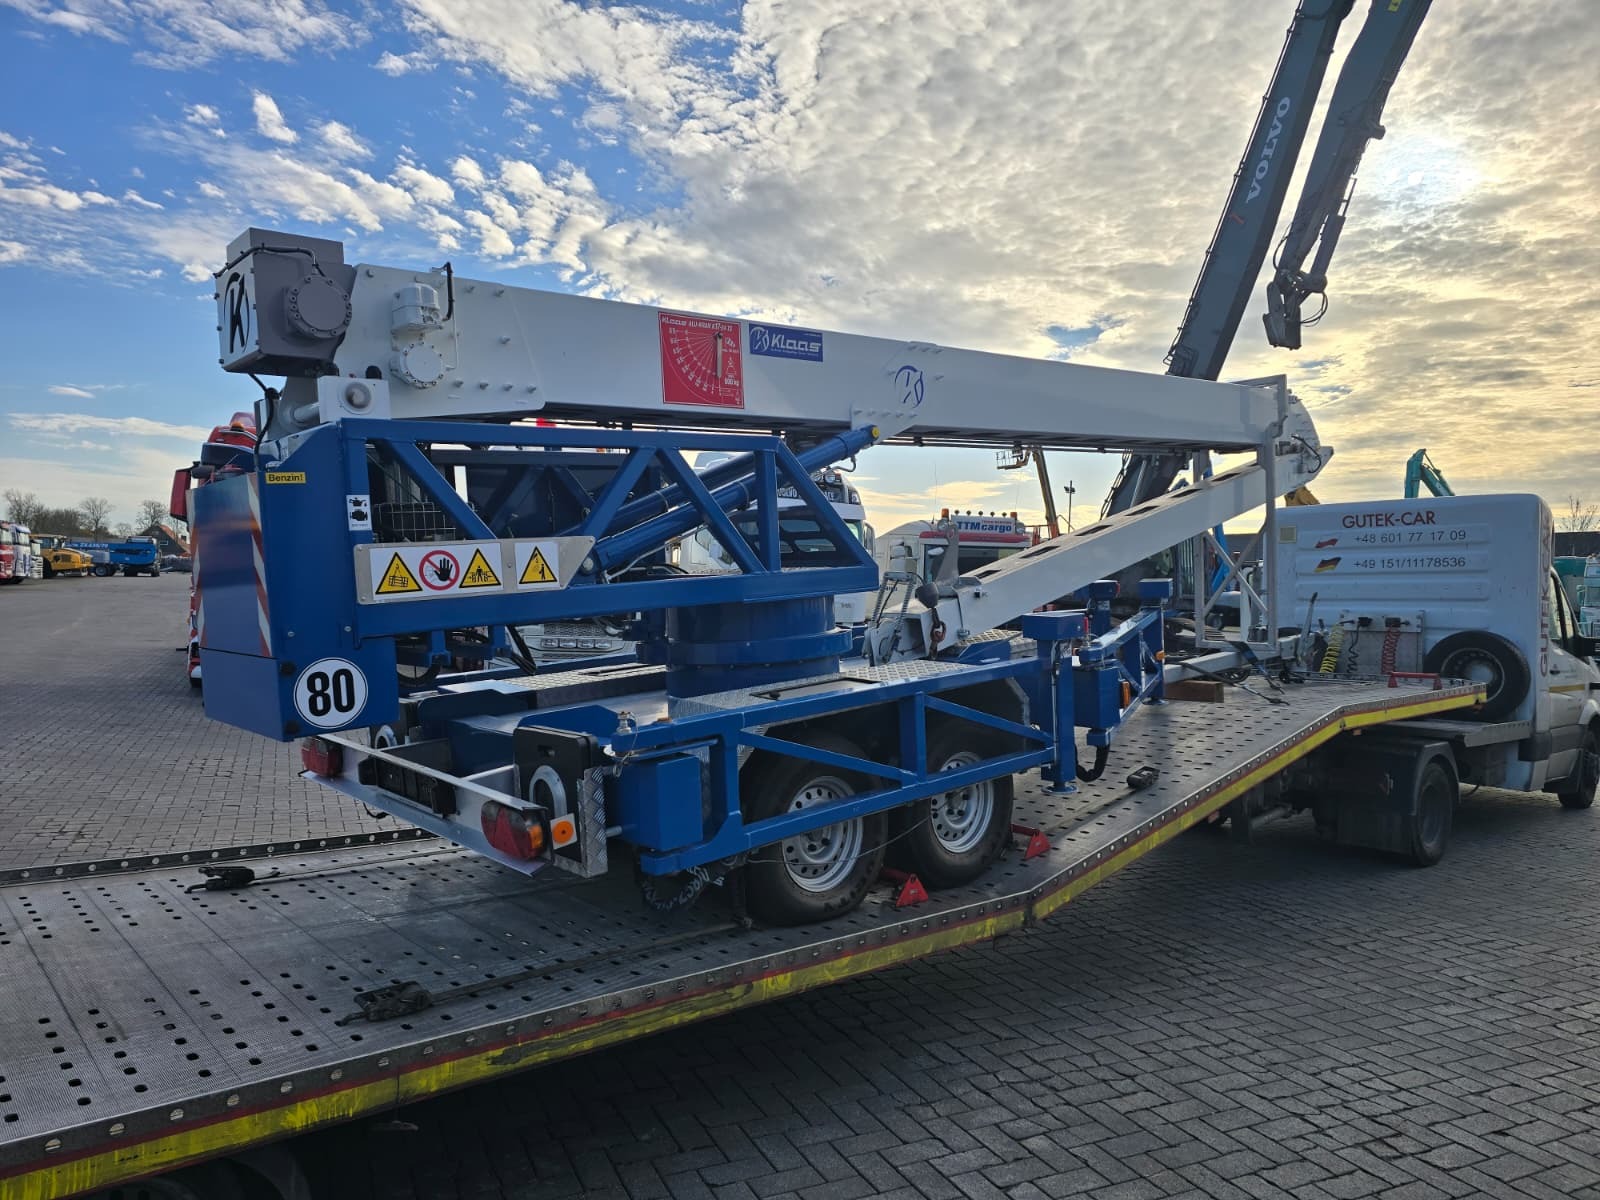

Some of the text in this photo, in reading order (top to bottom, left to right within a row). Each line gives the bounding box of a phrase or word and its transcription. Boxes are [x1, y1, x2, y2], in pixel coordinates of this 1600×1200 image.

[1245, 96, 1291, 204] VOLVO
[770, 333, 822, 353] Klaas
[268, 473, 304, 482] Benzin!
[956, 520, 1012, 533] TTMcargo
[1342, 510, 1437, 529] GUTEK-CAR
[1354, 529, 1467, 544] +48 601 77 17 09
[1353, 556, 1467, 569] +49 151/11178536
[306, 668, 356, 717] 80
